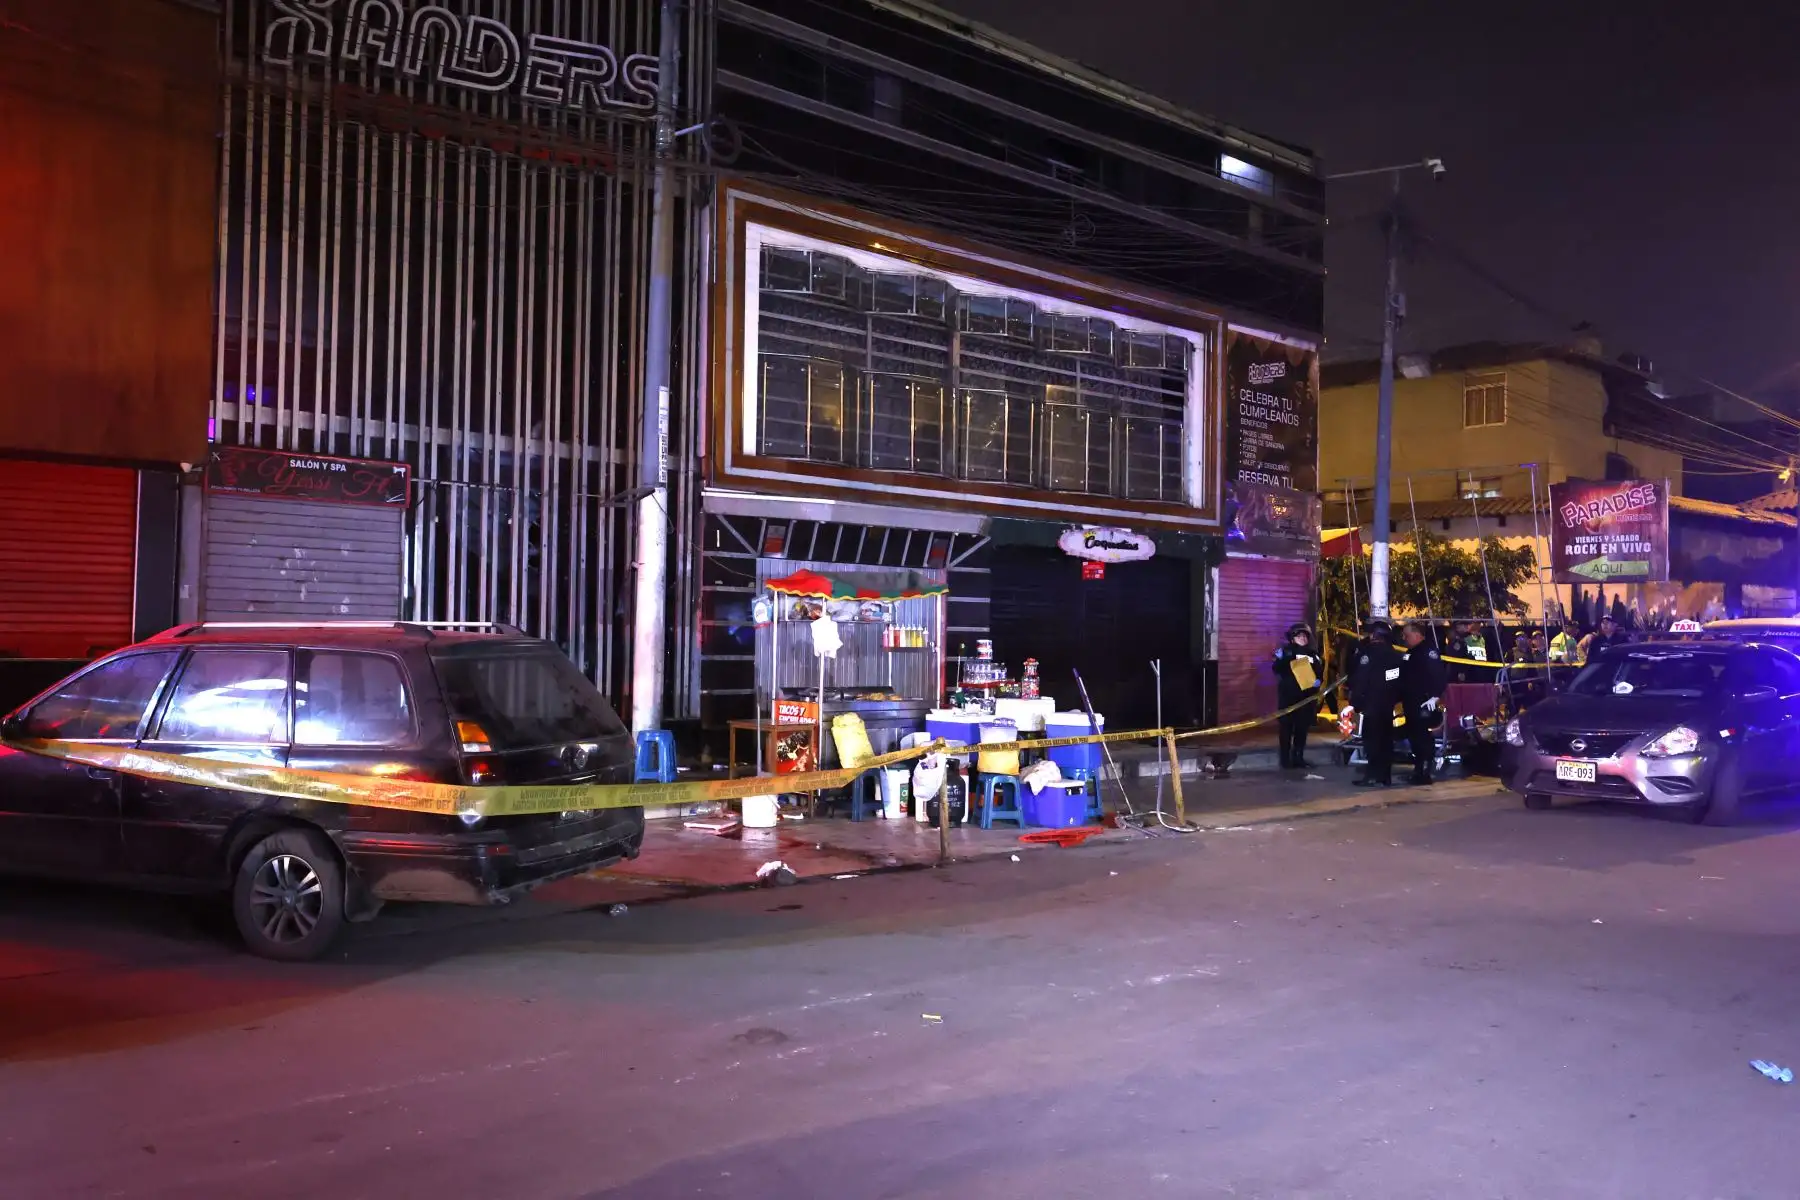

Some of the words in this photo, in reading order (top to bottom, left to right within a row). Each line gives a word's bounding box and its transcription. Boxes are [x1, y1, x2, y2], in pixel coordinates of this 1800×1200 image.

[1240, 388, 1279, 408] CELEBRA
[1281, 397, 1293, 411] TU
[1239, 403, 1300, 427] CUMPLEAÑOS
[290, 458, 321, 471] SALÓN
[321, 461, 329, 471] Y
[330, 463, 347, 473] SPA
[1238, 469, 1280, 488] RESERVA
[1281, 476, 1294, 490] TU
[1560, 484, 1657, 528] PARADISE
[1575, 536, 1603, 544] VIERNES
[1604, 535, 1609, 543] Y
[1611, 534, 1640, 543] SABADO
[1565, 543, 1598, 555] ROCK
[1601, 543, 1617, 554] EN
[1621, 542, 1652, 553] VIVO
[1591, 563, 1624, 574] AQUI
[1674, 623, 1696, 631] TAXI
[778, 704, 799, 717] TACOS
[799, 707, 806, 717] Y
